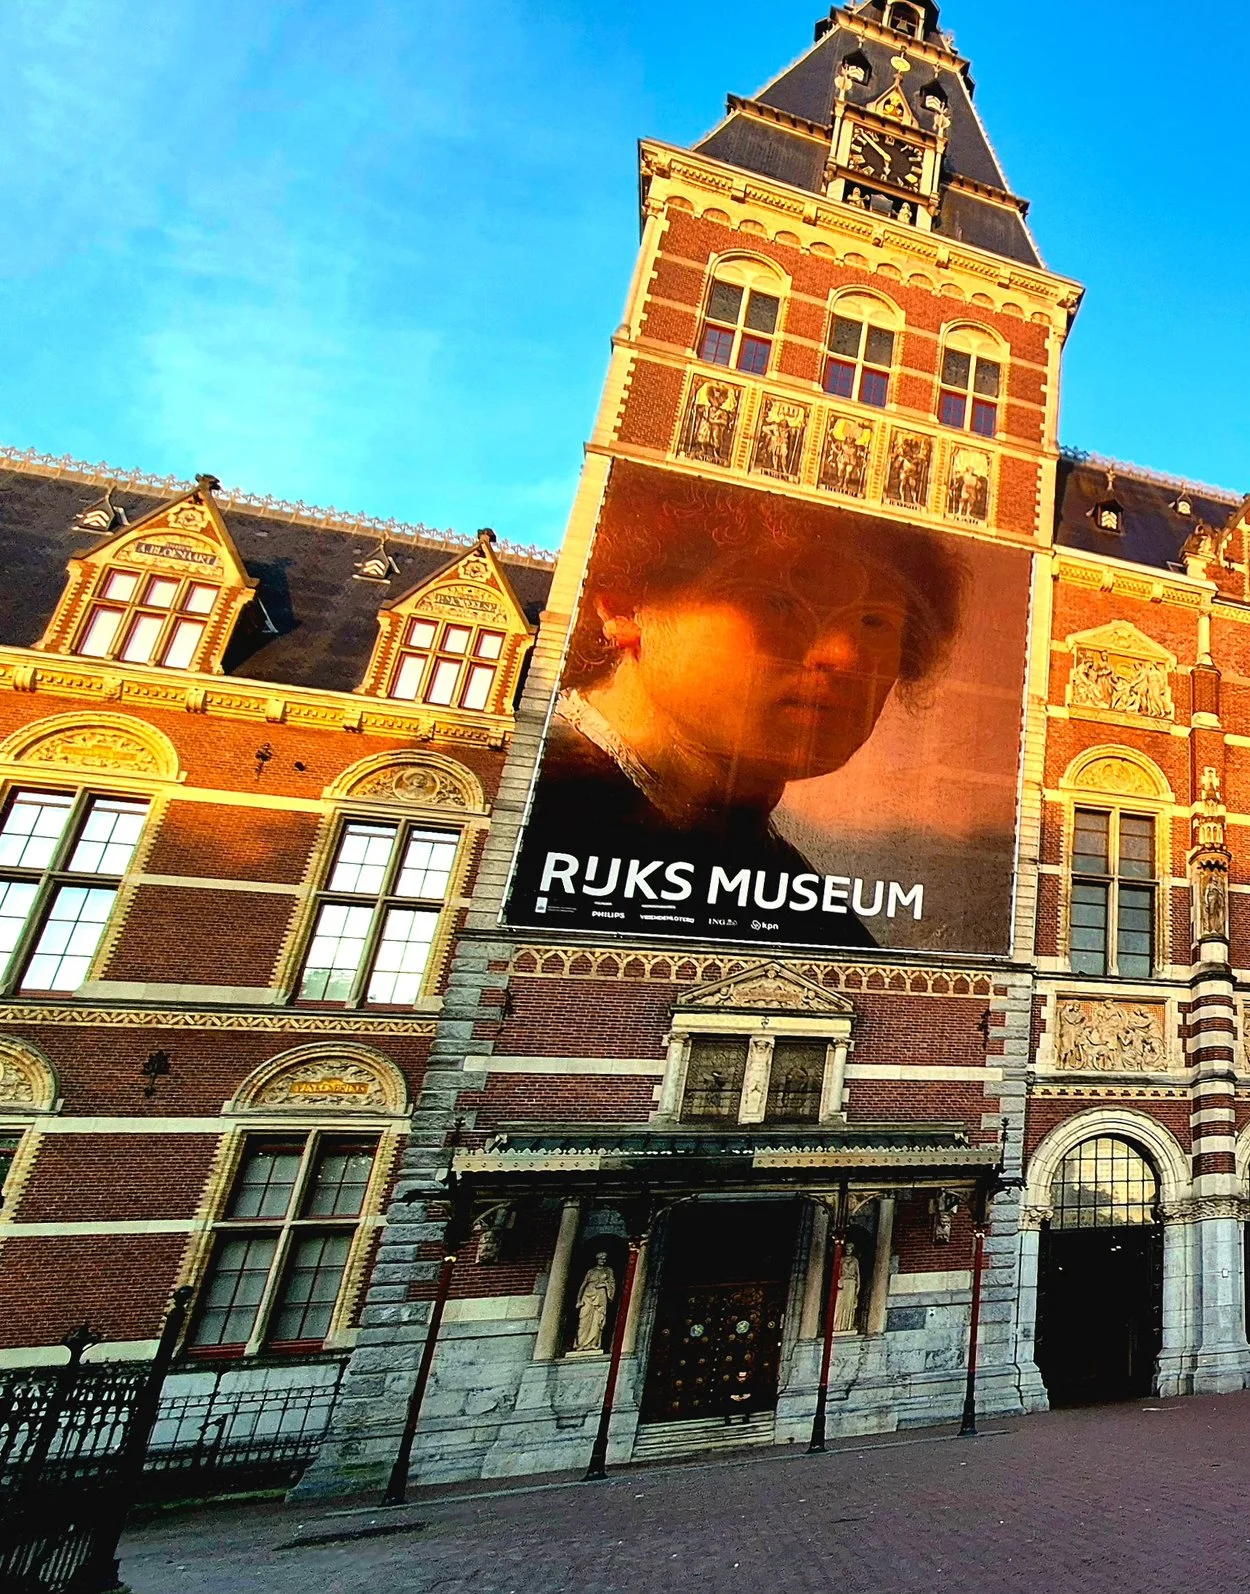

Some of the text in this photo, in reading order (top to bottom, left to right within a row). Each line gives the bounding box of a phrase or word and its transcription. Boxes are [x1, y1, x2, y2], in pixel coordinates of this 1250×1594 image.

[540, 852, 923, 919] RIJKS MUSEUM
[592, 910, 625, 918] PHILIPS
[709, 918, 726, 926] ING
[761, 922, 778, 930] kpn
